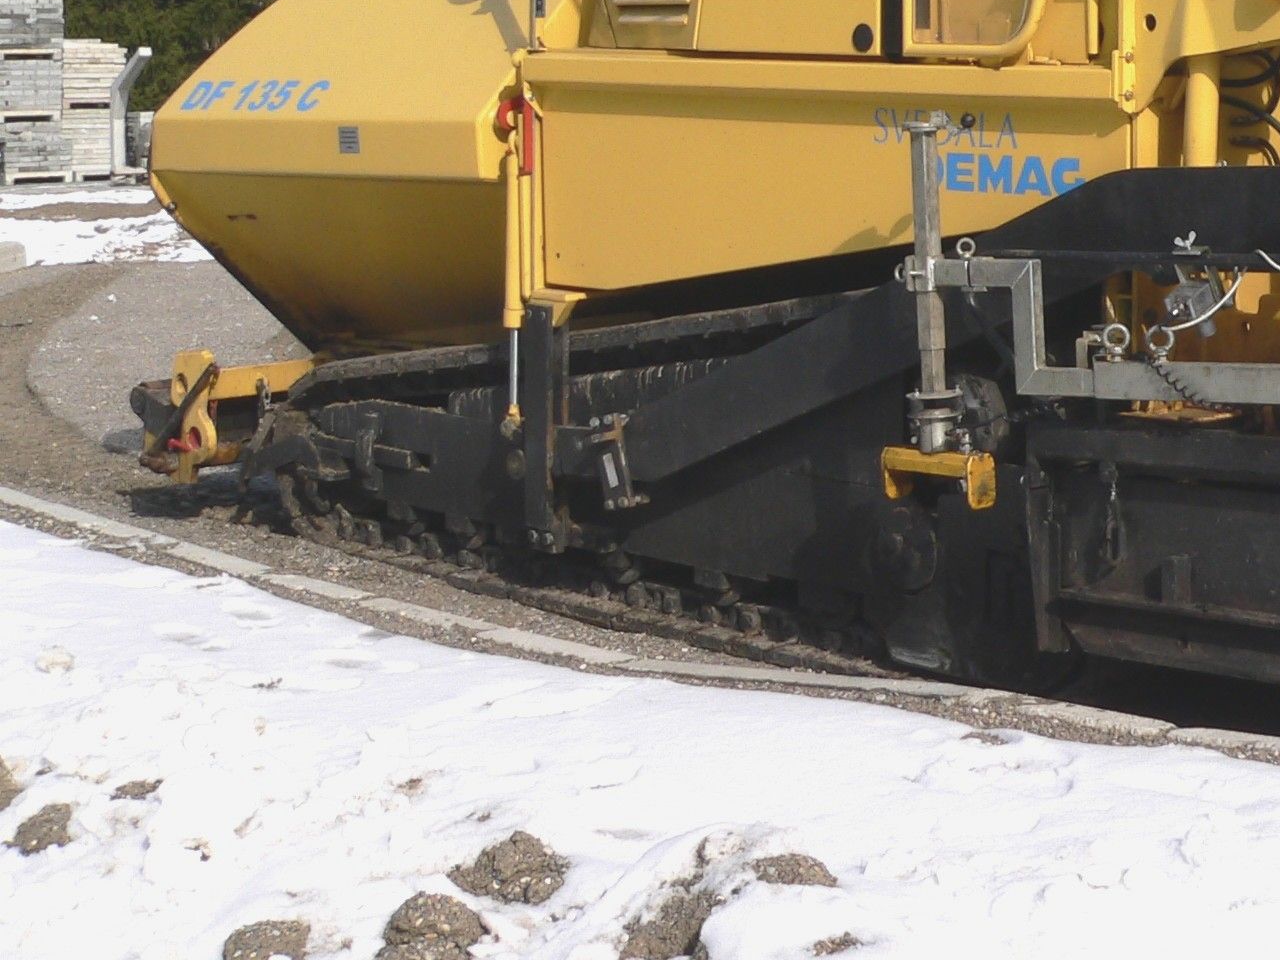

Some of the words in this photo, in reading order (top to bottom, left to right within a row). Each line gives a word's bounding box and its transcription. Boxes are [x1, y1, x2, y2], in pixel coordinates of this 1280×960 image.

[180, 80, 236, 110] DF
[233, 79, 299, 111] 135
[296, 79, 330, 111] C
[936, 152, 1086, 196] EMAG
